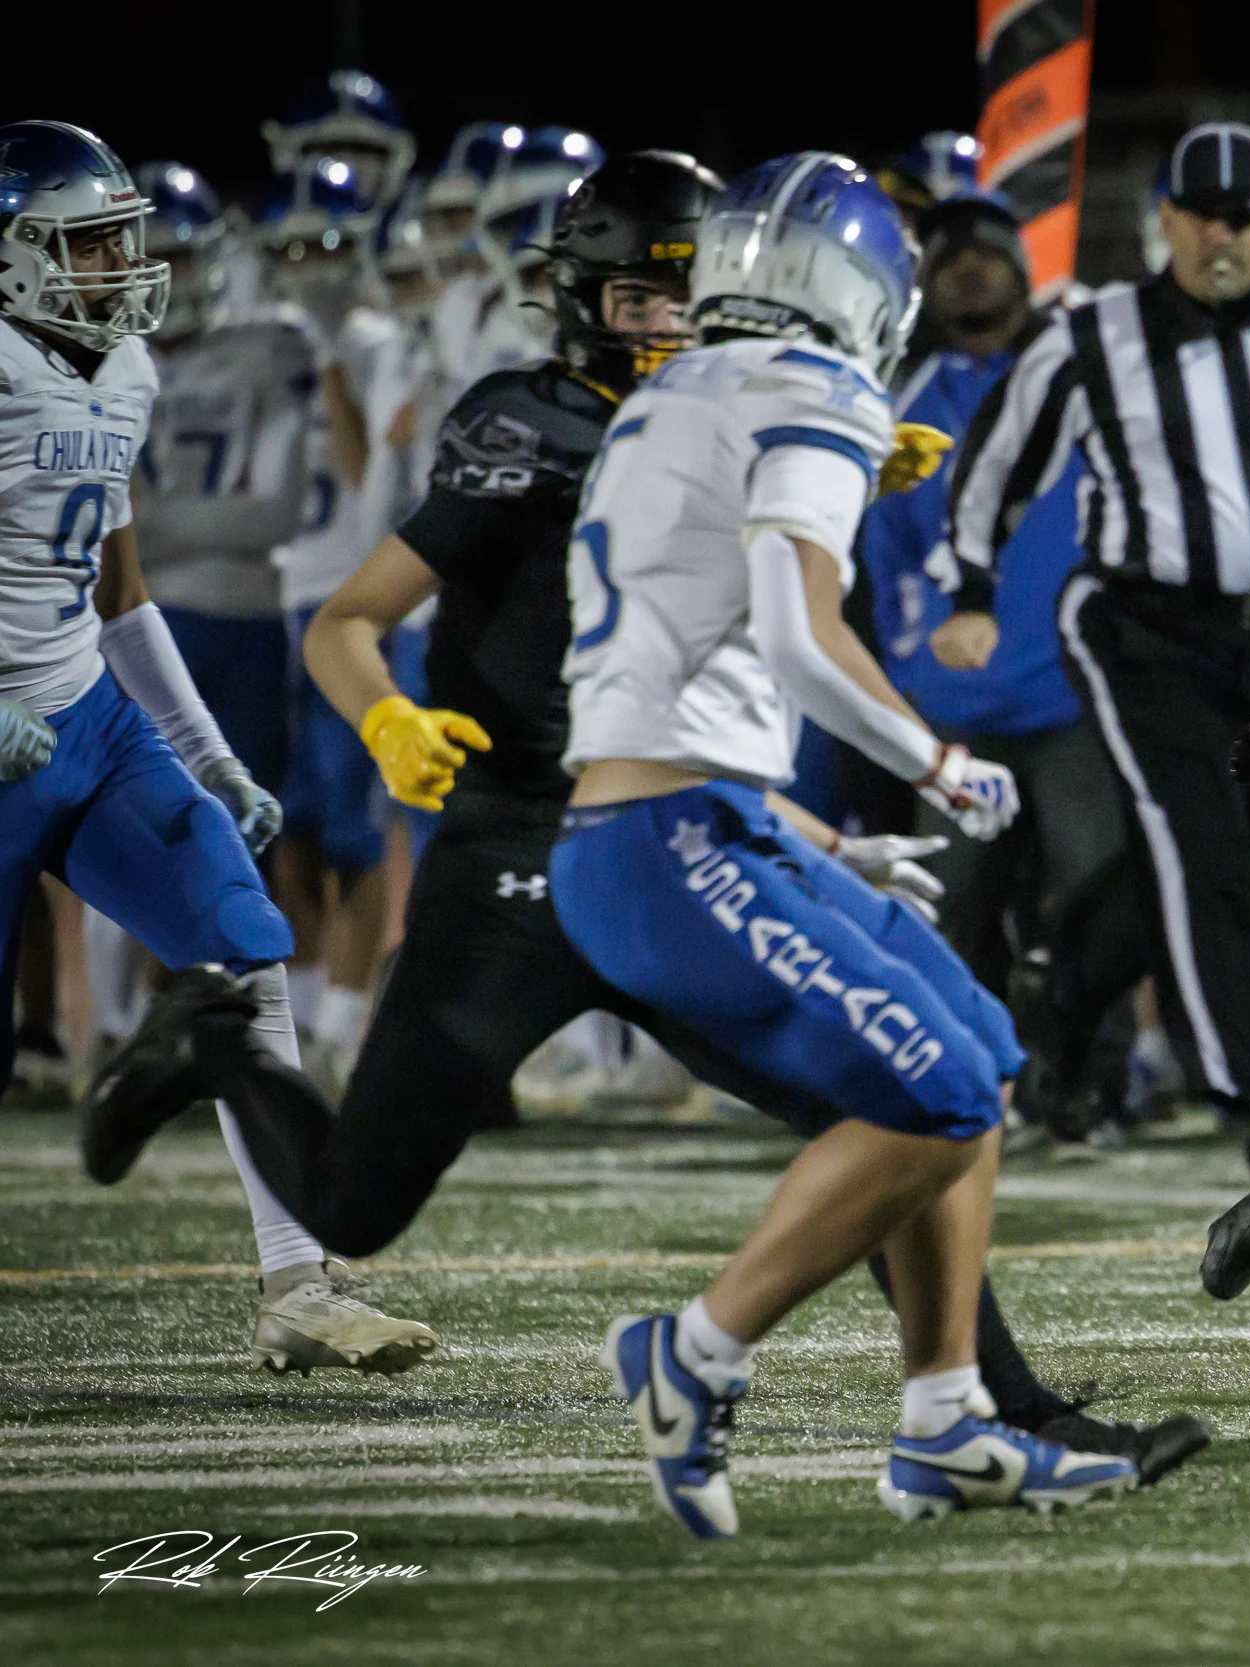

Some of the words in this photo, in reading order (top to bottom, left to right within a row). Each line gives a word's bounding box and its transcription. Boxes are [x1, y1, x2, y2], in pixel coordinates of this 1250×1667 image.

[34, 429, 98, 471] CHULA
[52, 481, 105, 622] 9
[686, 850, 944, 1082] SPARTANS
